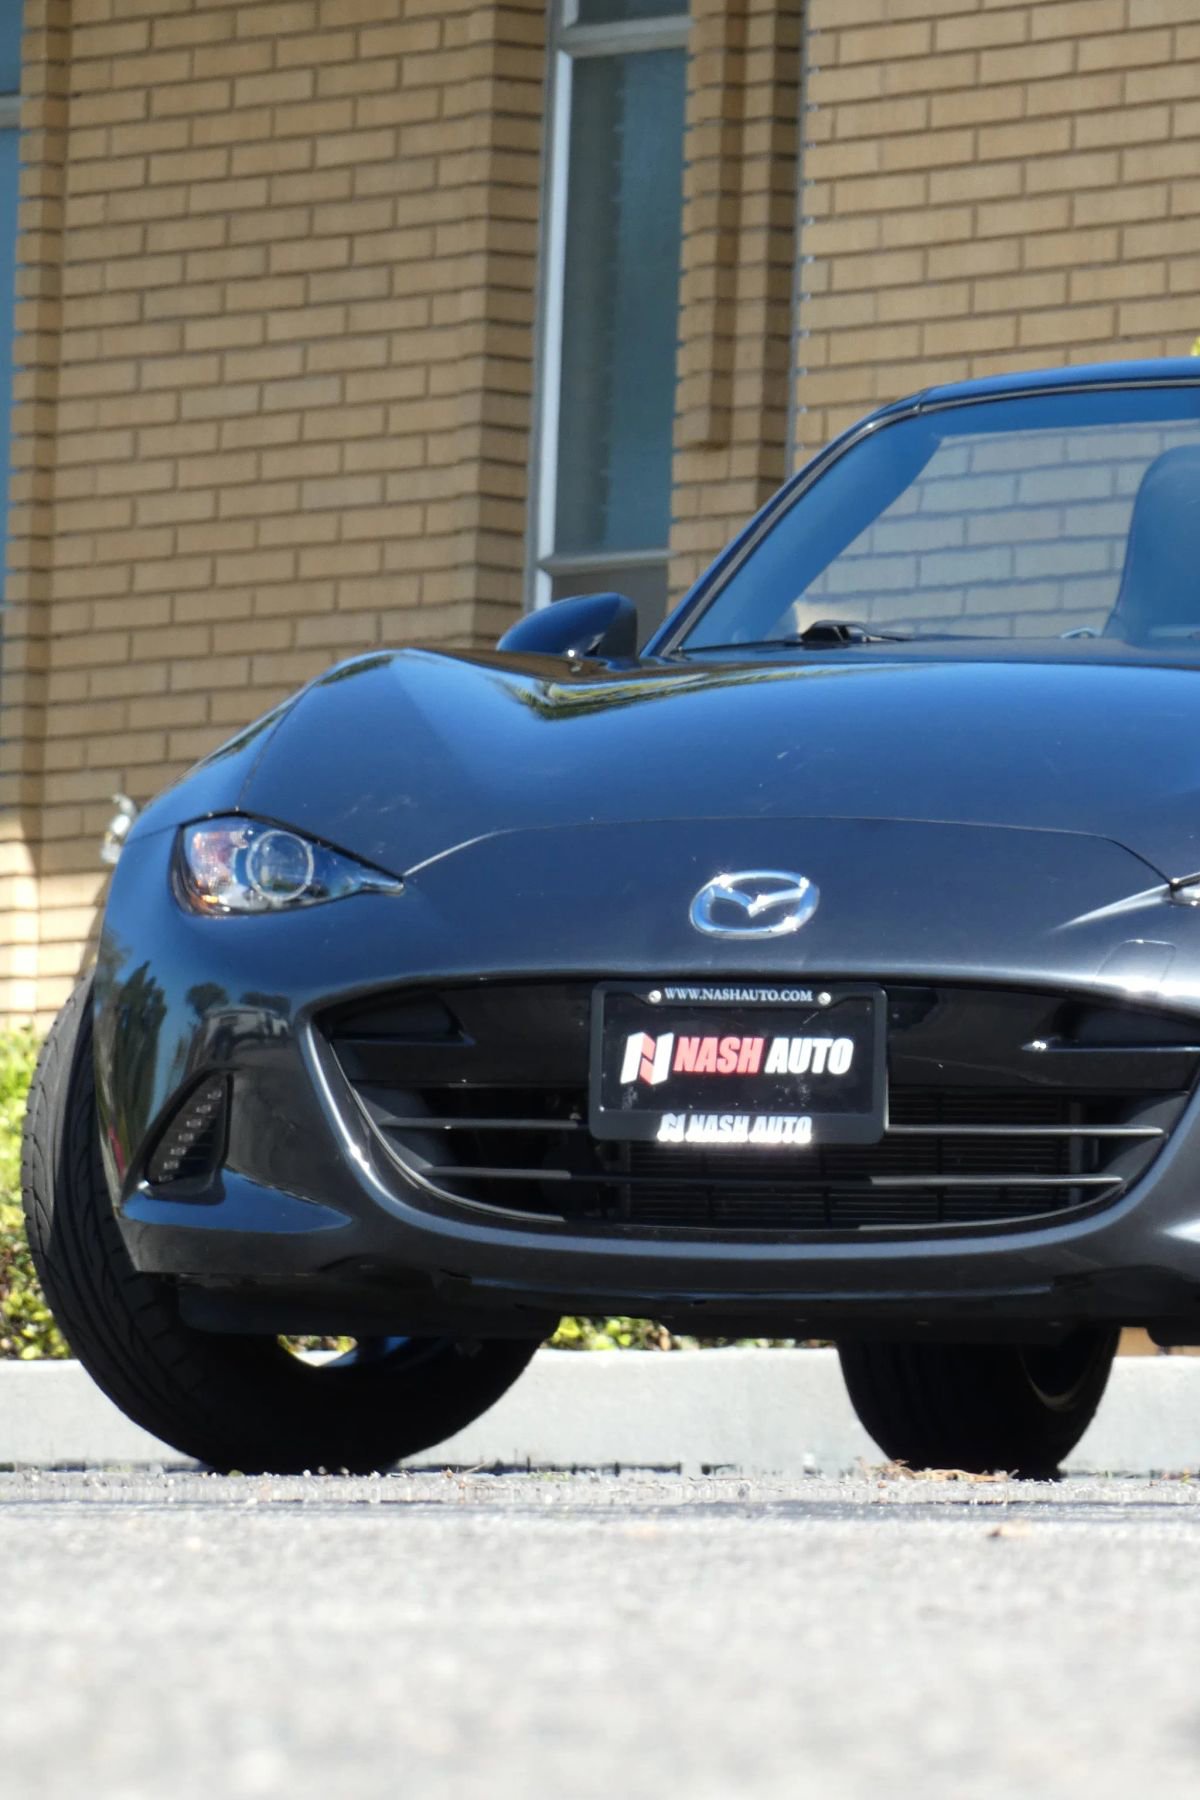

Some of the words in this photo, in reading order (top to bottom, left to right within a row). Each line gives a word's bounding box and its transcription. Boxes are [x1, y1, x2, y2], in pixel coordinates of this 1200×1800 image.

[664, 987, 813, 1002] WWW.NASHAUTO.COM
[673, 1036, 766, 1074] NASH
[764, 1037, 854, 1075] AUTO
[685, 1114, 749, 1143] NASH
[749, 1115, 812, 1144] AUTO
